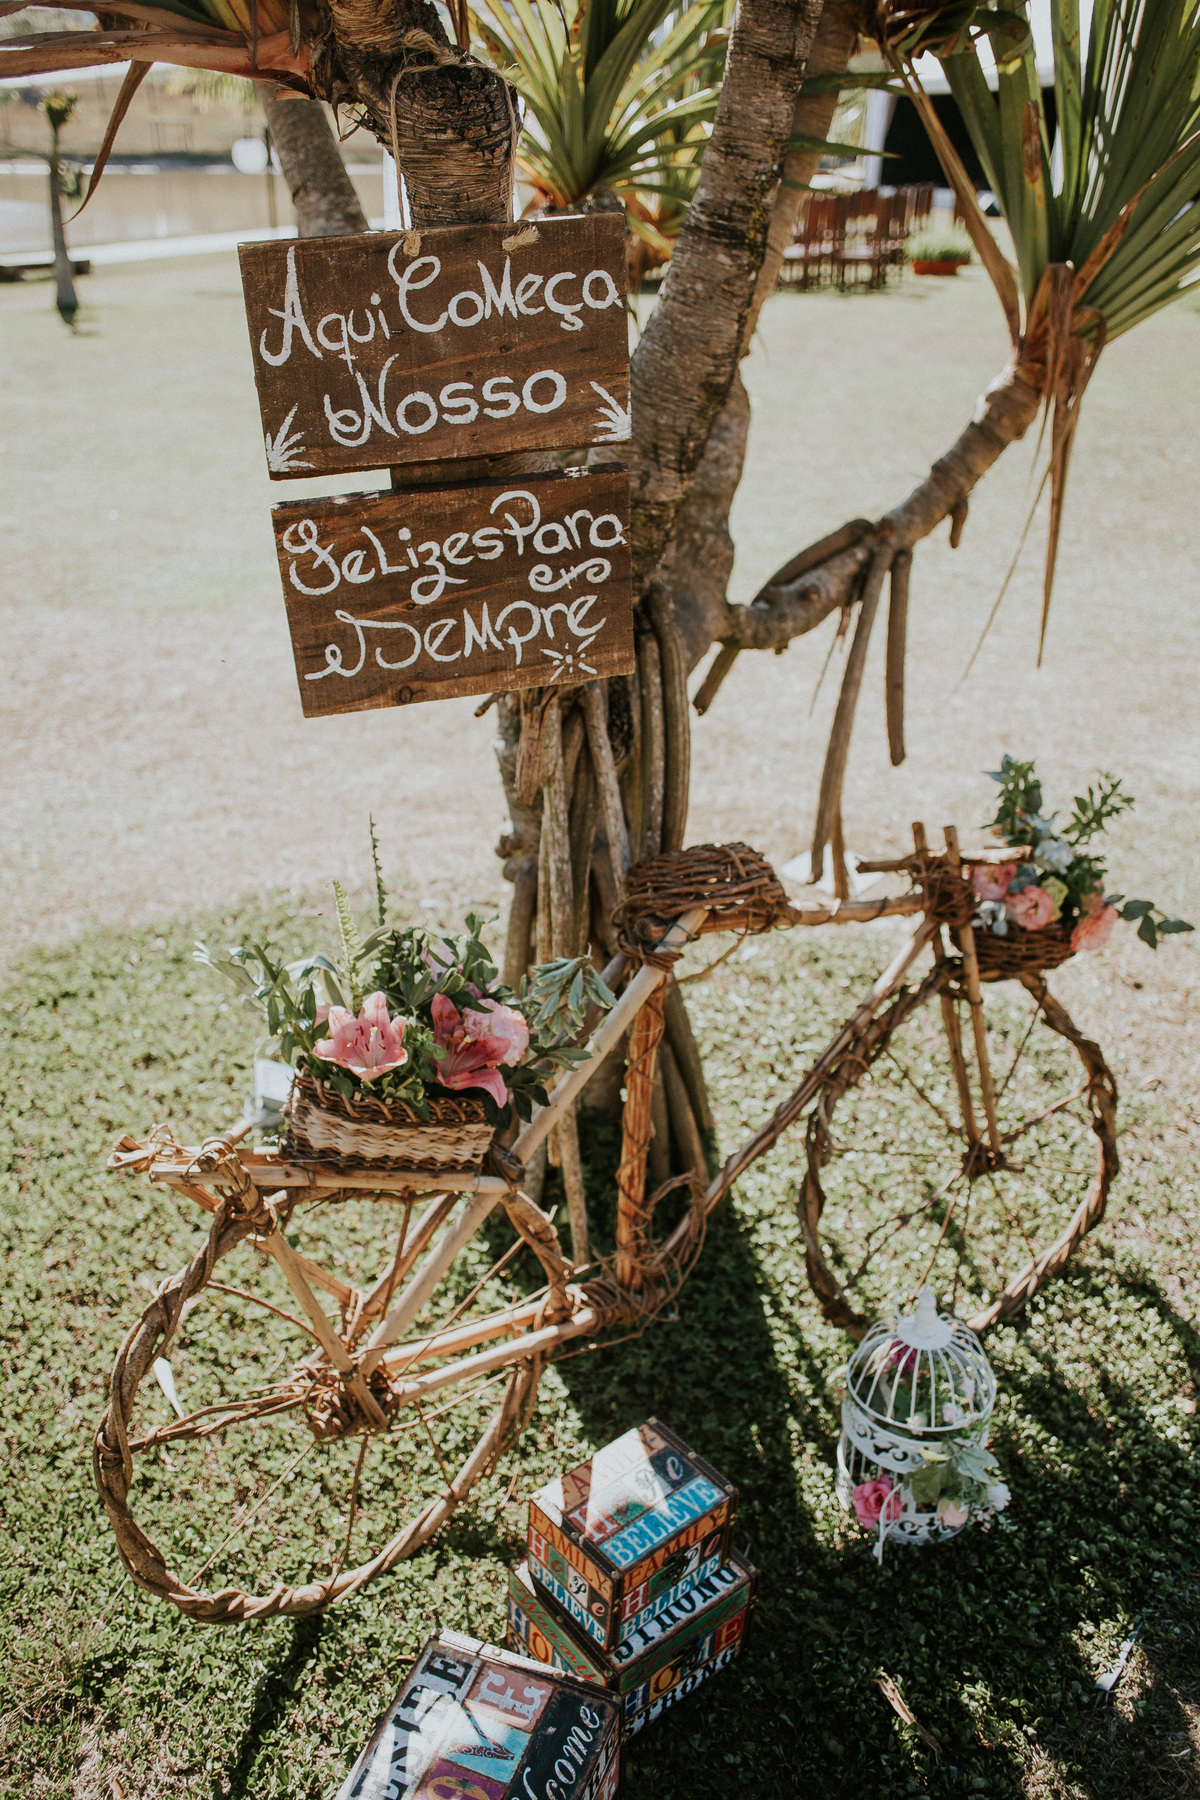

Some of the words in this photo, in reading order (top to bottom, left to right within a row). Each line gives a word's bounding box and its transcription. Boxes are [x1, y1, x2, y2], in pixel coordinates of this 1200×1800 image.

[259, 246, 391, 376] Aqui
[323, 353, 567, 447] Nosso
[489, 490, 628, 556] Para
[532, 1509, 609, 1591] FAMILY
[604, 1478, 720, 1565] BELIEVE
[627, 1505, 726, 1590] FAMILY
[529, 1556, 605, 1647] BELIEVE
[622, 1552, 720, 1638] BELIEVE
